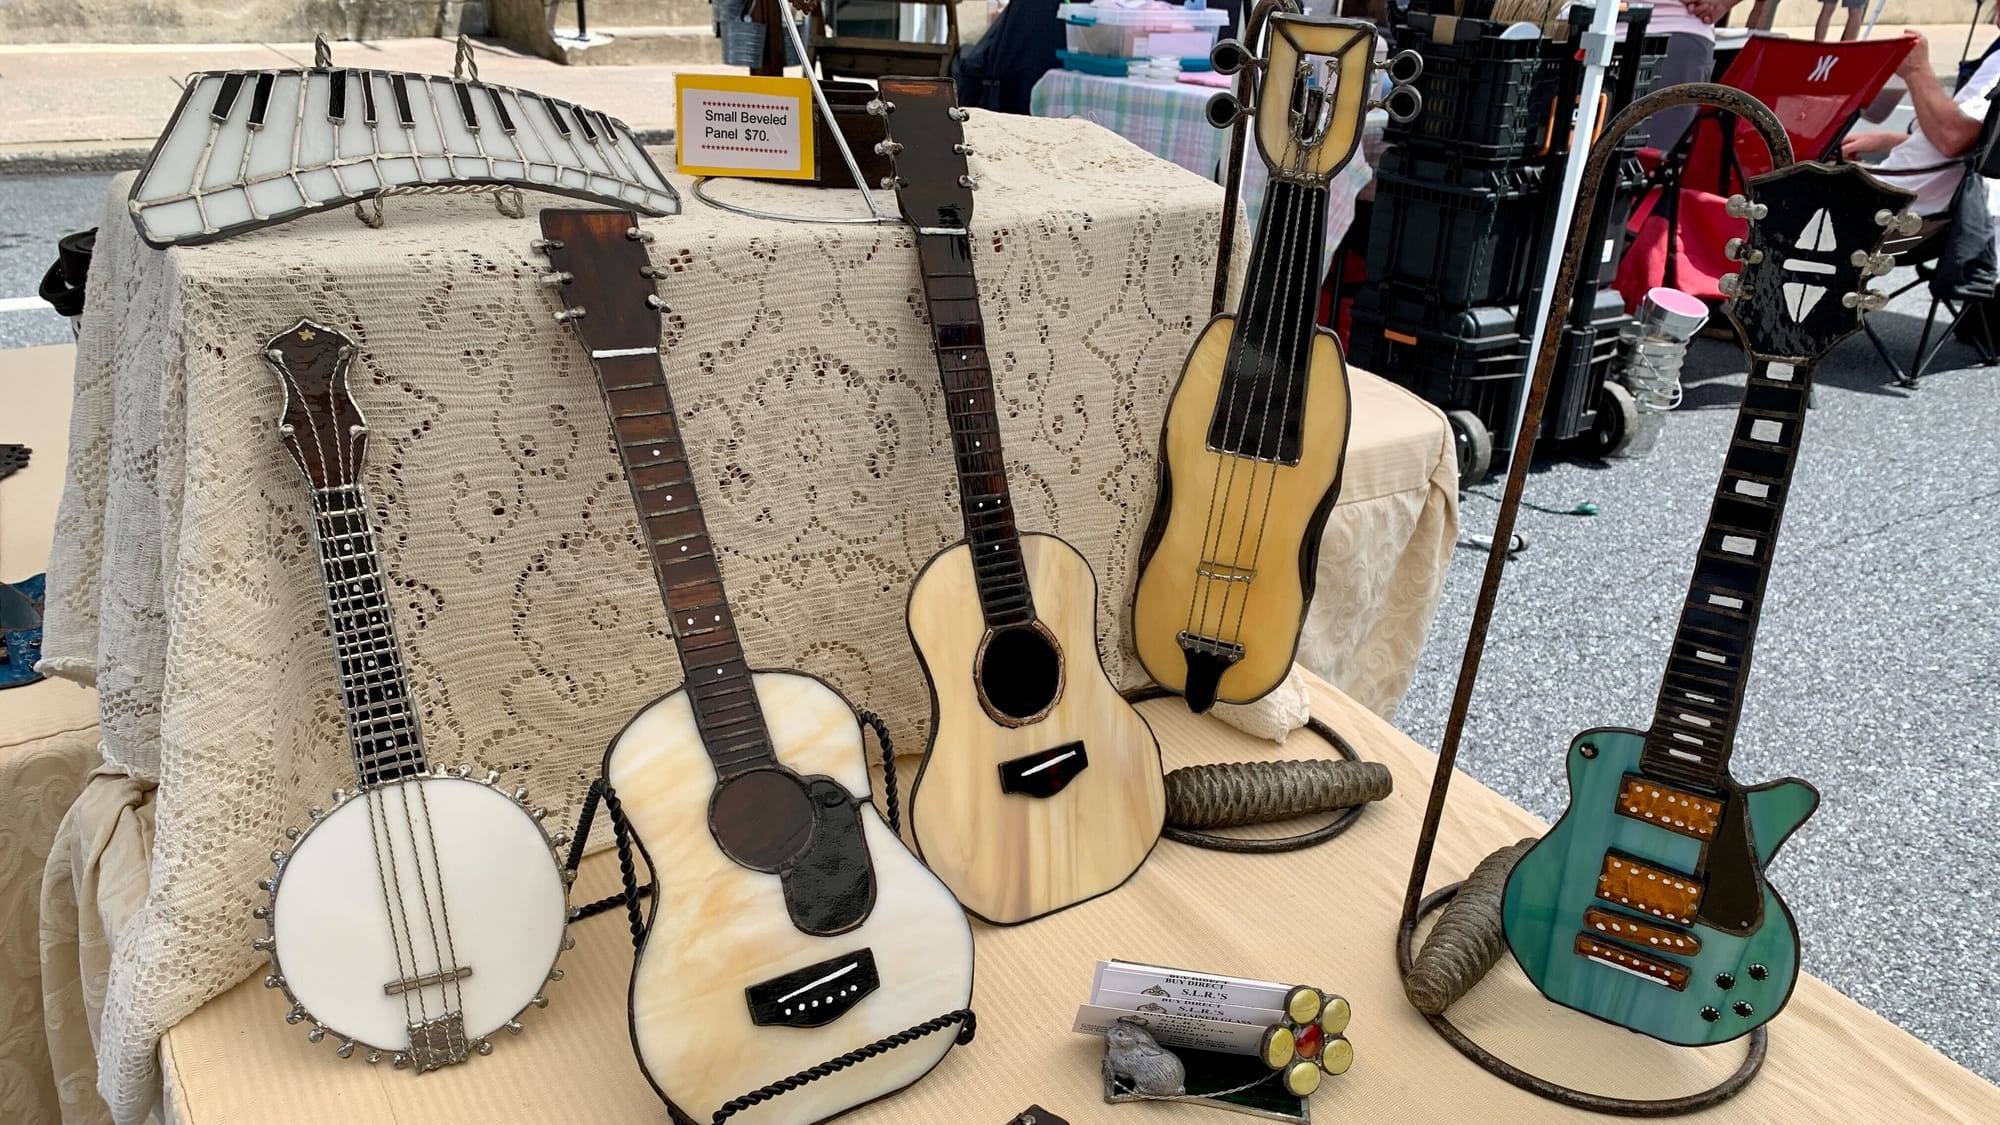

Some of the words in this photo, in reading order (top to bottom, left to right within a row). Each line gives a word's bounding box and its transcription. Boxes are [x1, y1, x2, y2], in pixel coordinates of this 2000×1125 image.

[705, 109, 737, 123] Small
[741, 112, 787, 126] Beveled
[705, 127, 738, 140] Panel
[744, 128, 769, 142] $70.
[1187, 980, 1226, 990] DIRECT
[1181, 988, 1228, 1000] S.L.R.'S
[1184, 1000, 1221, 1008] DIRECT
